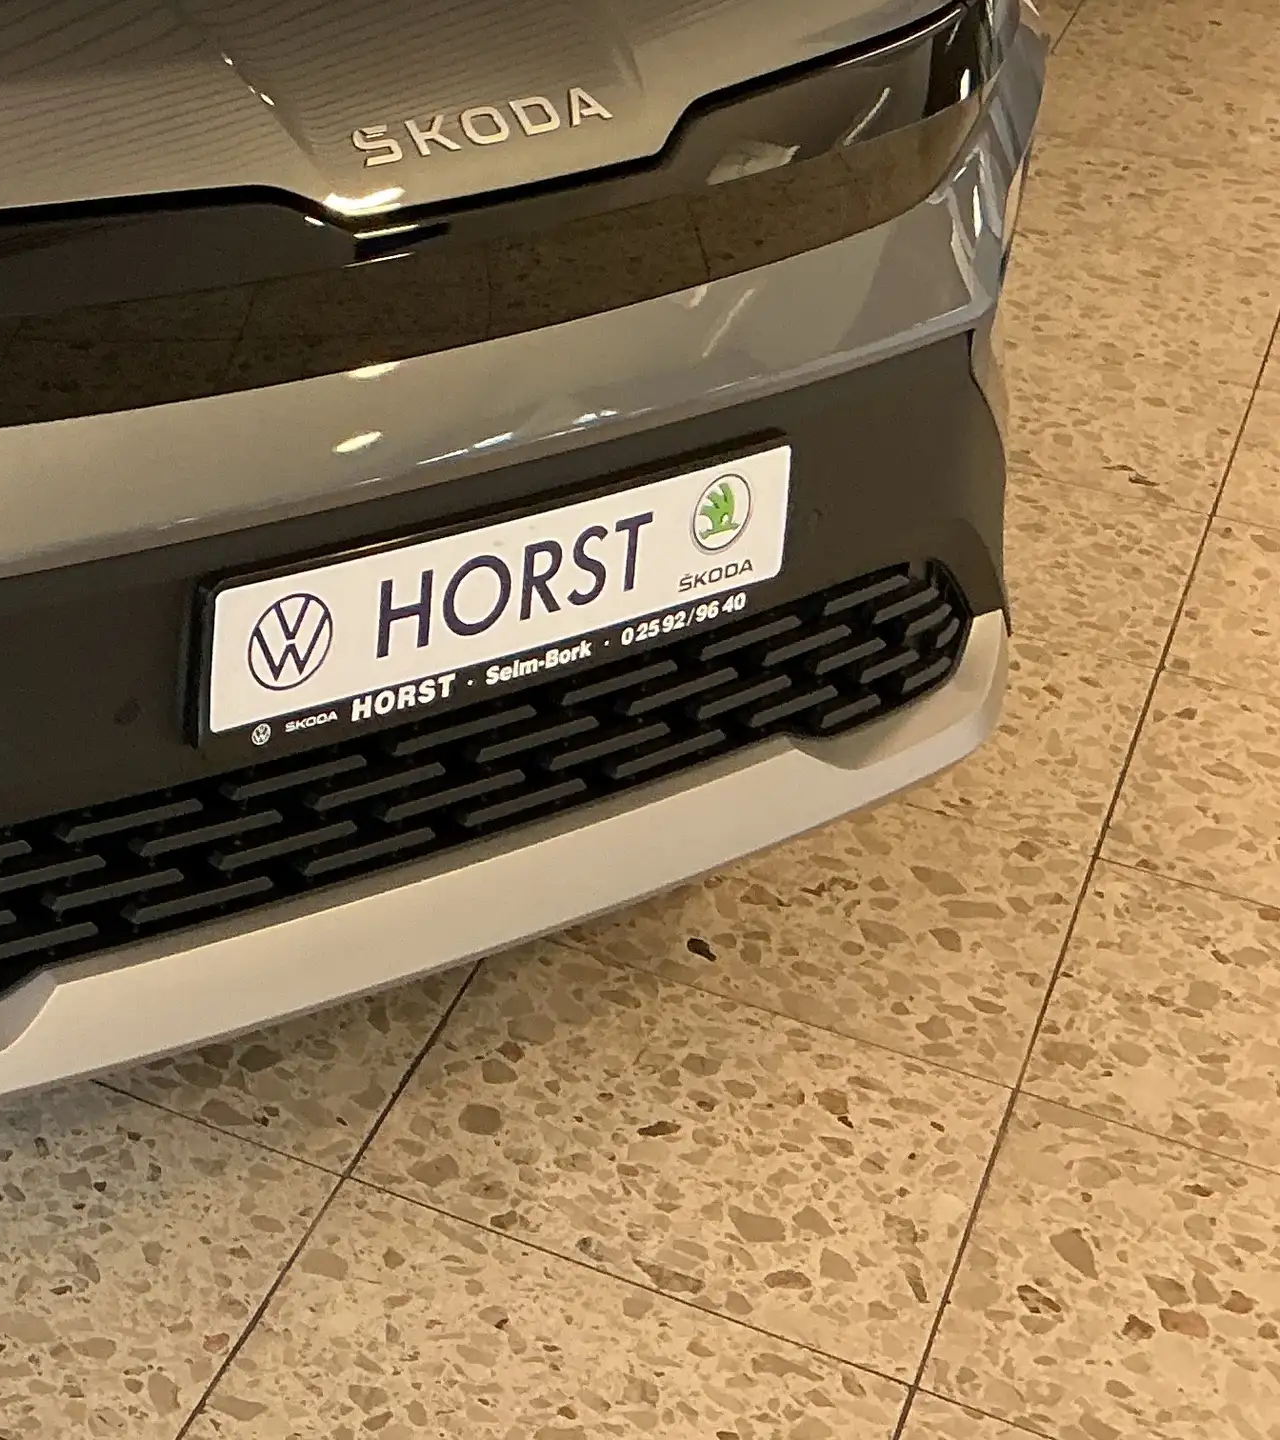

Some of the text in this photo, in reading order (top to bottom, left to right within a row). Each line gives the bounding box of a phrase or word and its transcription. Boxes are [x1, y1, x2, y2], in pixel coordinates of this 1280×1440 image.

[375, 511, 655, 658] HORST
[350, 672, 457, 723] HORST
[485, 638, 592, 686] Selm-Bork
